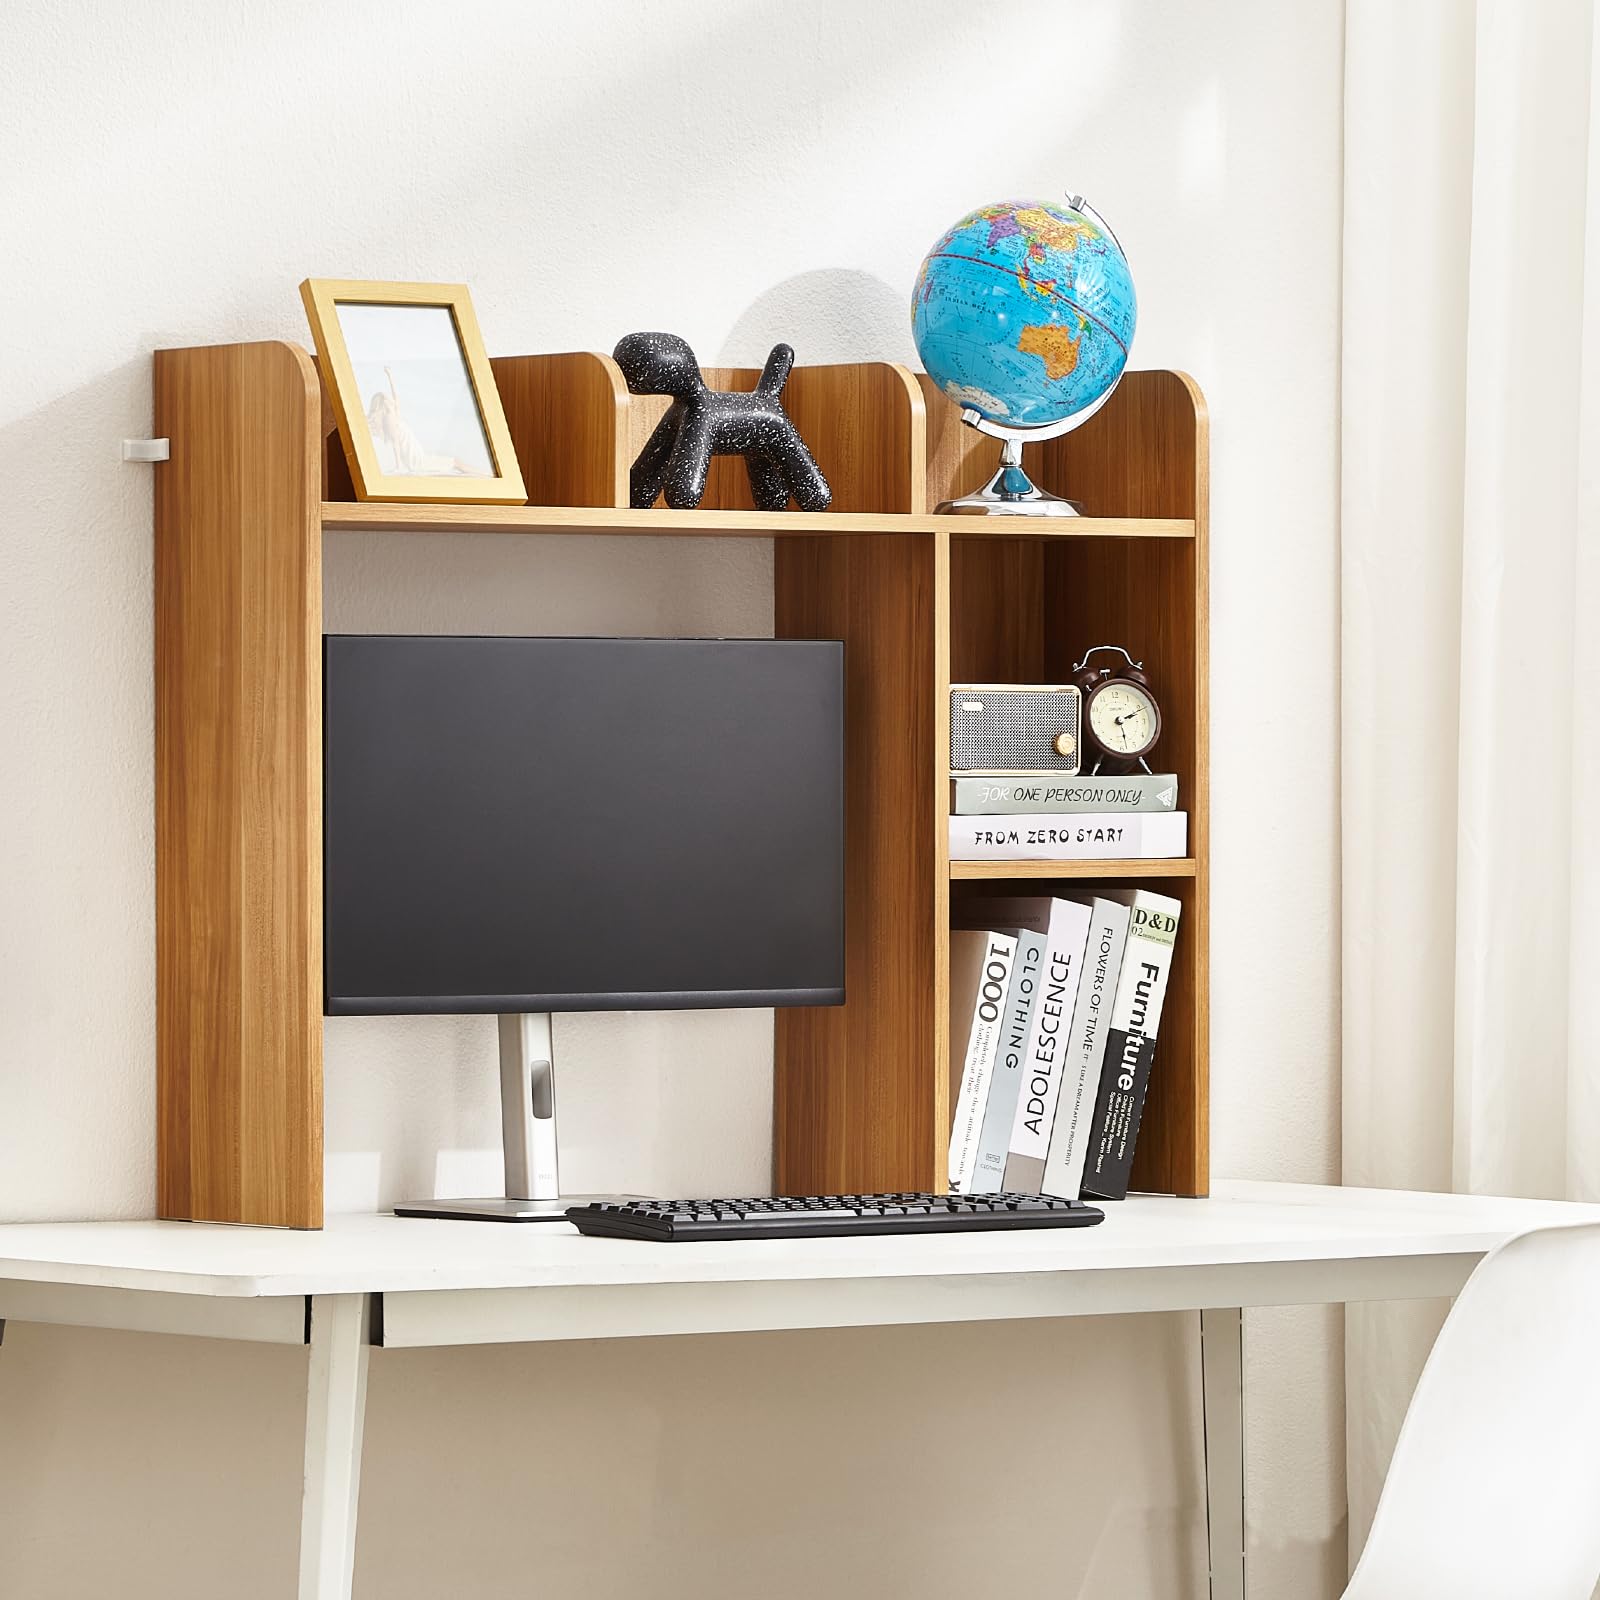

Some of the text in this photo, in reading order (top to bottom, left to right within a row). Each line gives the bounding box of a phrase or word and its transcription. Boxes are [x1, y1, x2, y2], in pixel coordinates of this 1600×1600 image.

[1013, 787, 1042, 801] ONE
[1044, 788, 1103, 803] PERSON
[974, 828, 1123, 845] FROM ZERO START
[1131, 925, 1144, 937] 02
[978, 943, 1010, 1023] 1000
[1082, 927, 1113, 1051] FLOWERS OF TIME
[1006, 948, 1039, 1069] CLOTHING
[1117, 961, 1160, 1091] Furniture
[1024, 952, 1071, 1135] ADOLESCENCE
[1104, 1133, 1114, 1153] System
[1116, 1140, 1126, 1160] Design
